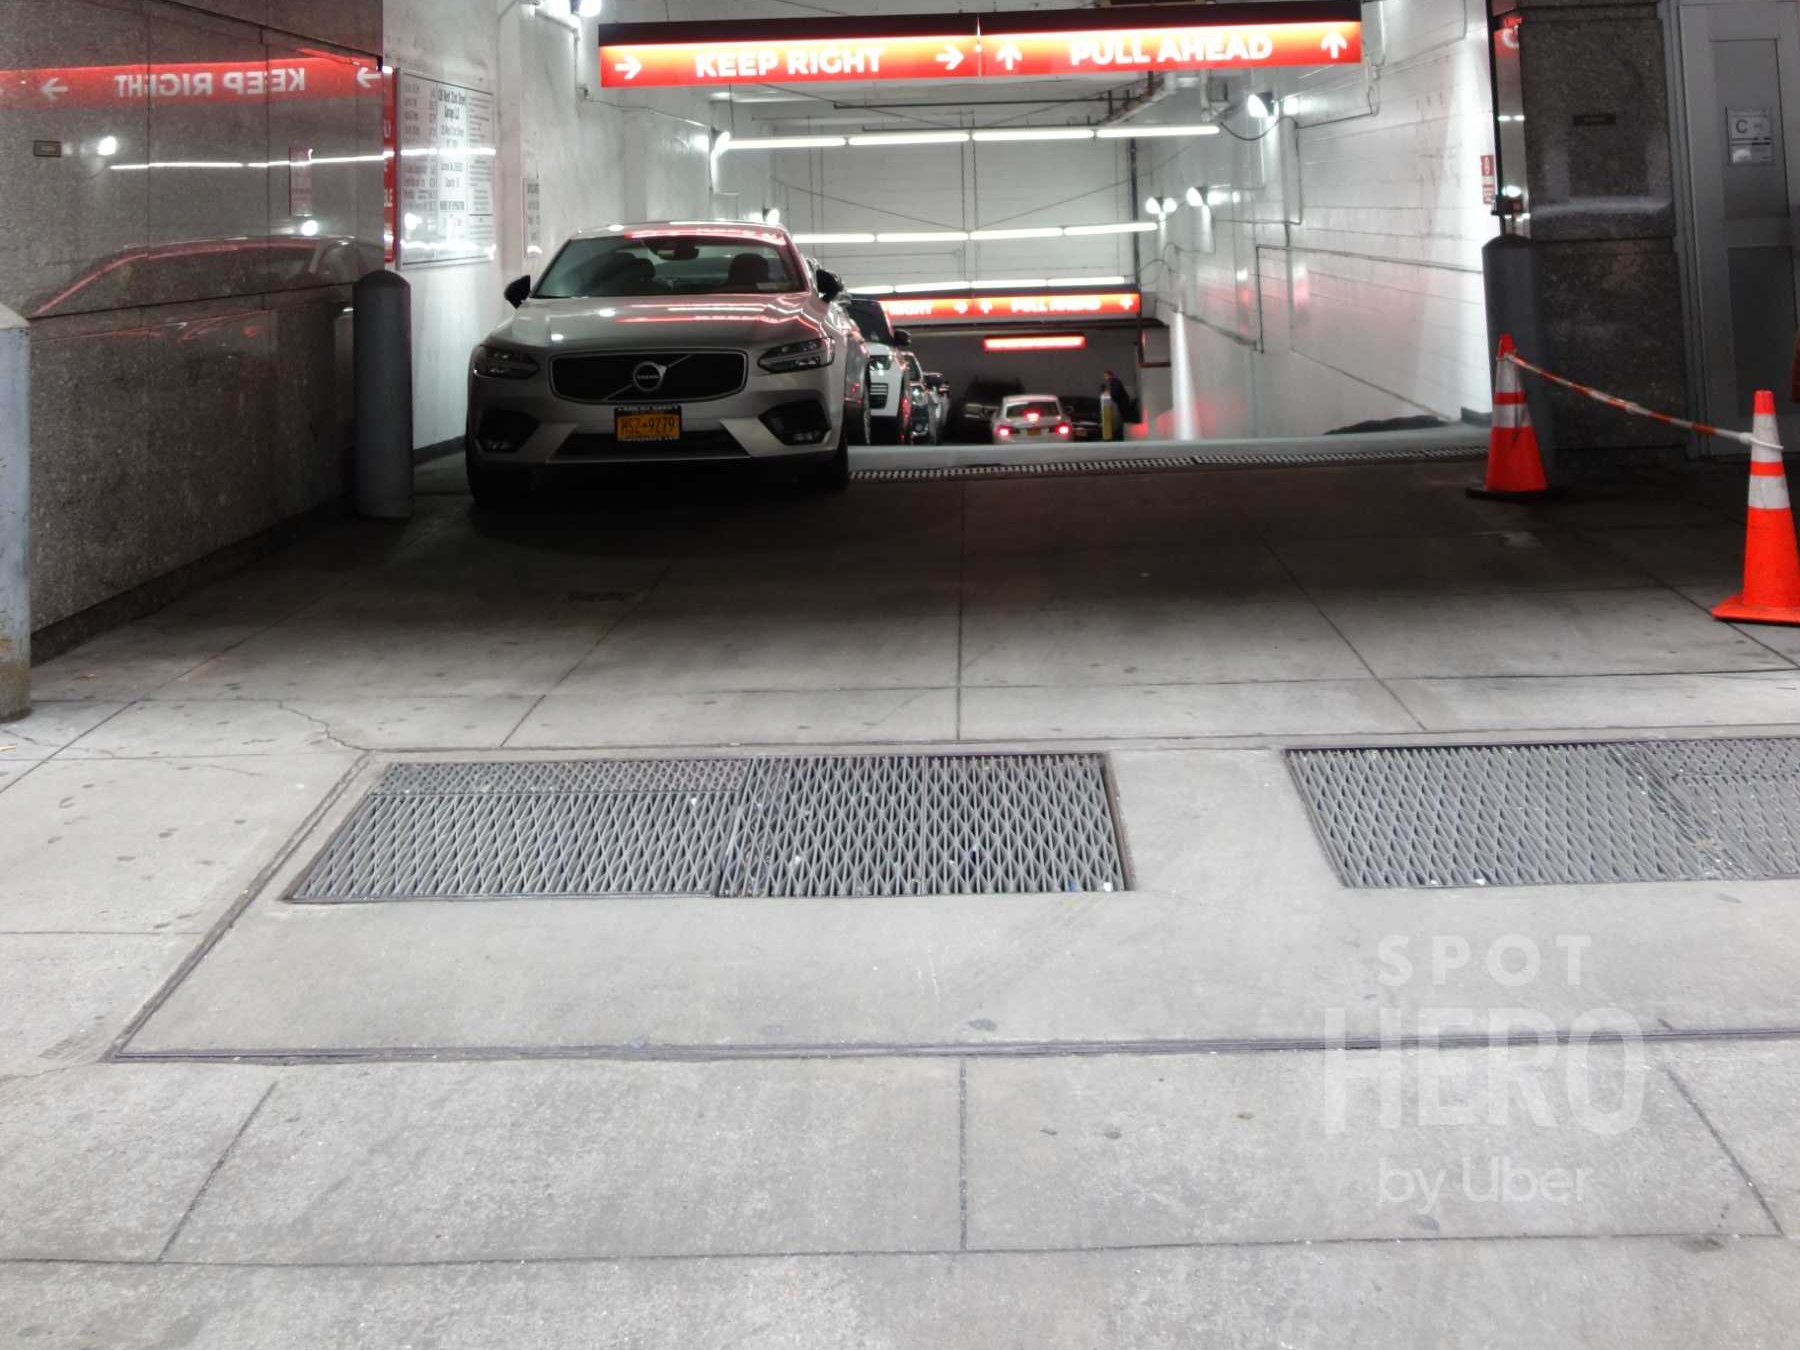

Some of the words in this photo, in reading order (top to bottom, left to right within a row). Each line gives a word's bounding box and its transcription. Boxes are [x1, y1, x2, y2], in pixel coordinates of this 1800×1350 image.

[695, 51, 779, 78] KEEP
[787, 47, 882, 75] RIGHT
[1071, 36, 1151, 66] PULL
[1156, 32, 1273, 63] AHEAD
